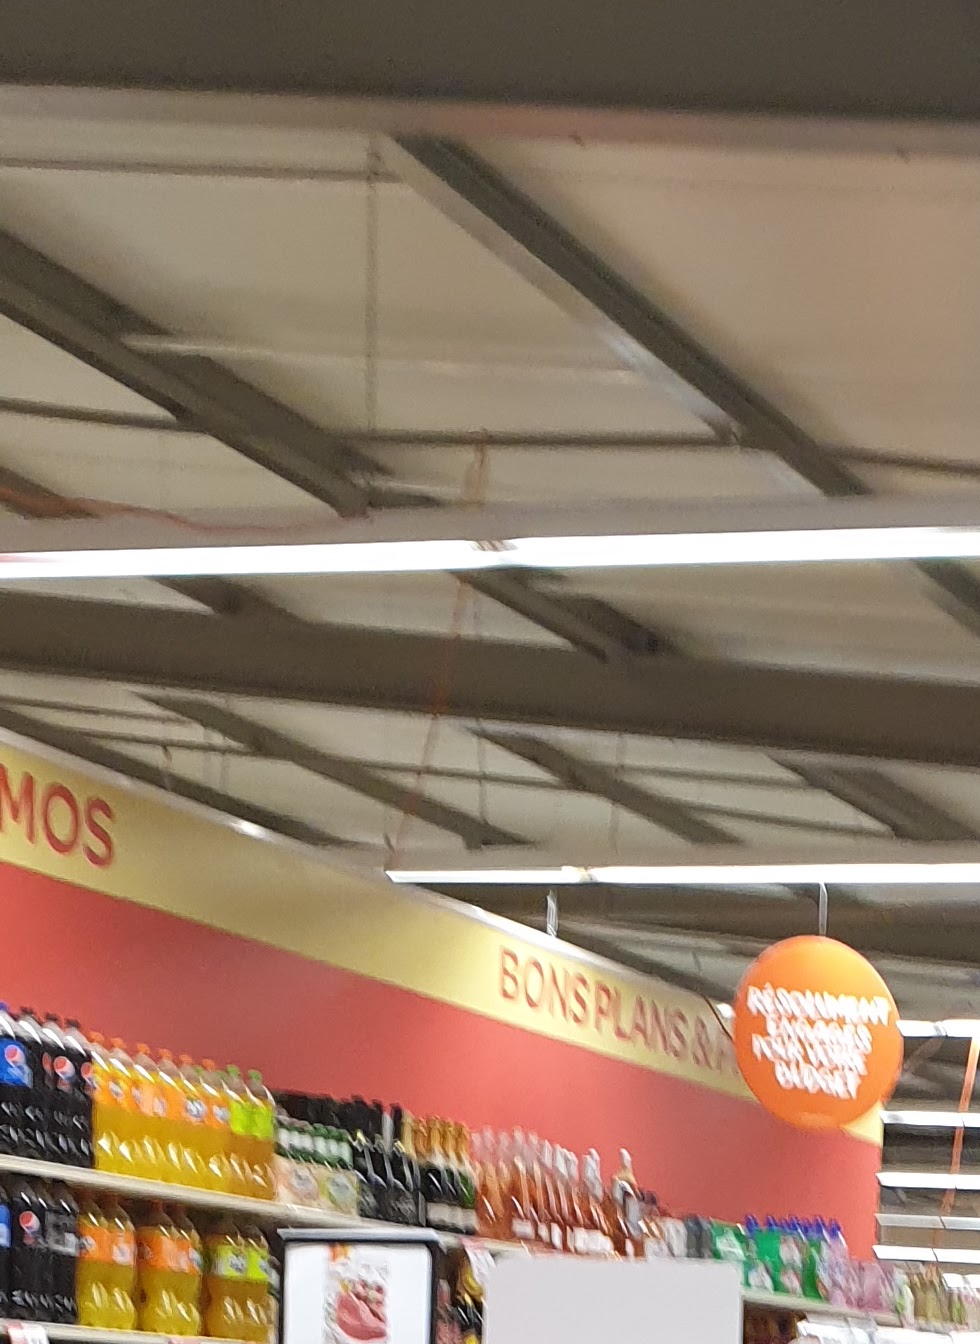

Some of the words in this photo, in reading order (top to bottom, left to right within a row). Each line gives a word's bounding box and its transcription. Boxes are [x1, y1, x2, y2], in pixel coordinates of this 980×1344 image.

[0, 763, 114, 869] MOS
[499, 946, 588, 1025] BONS
[596, 981, 687, 1059] PLANS
